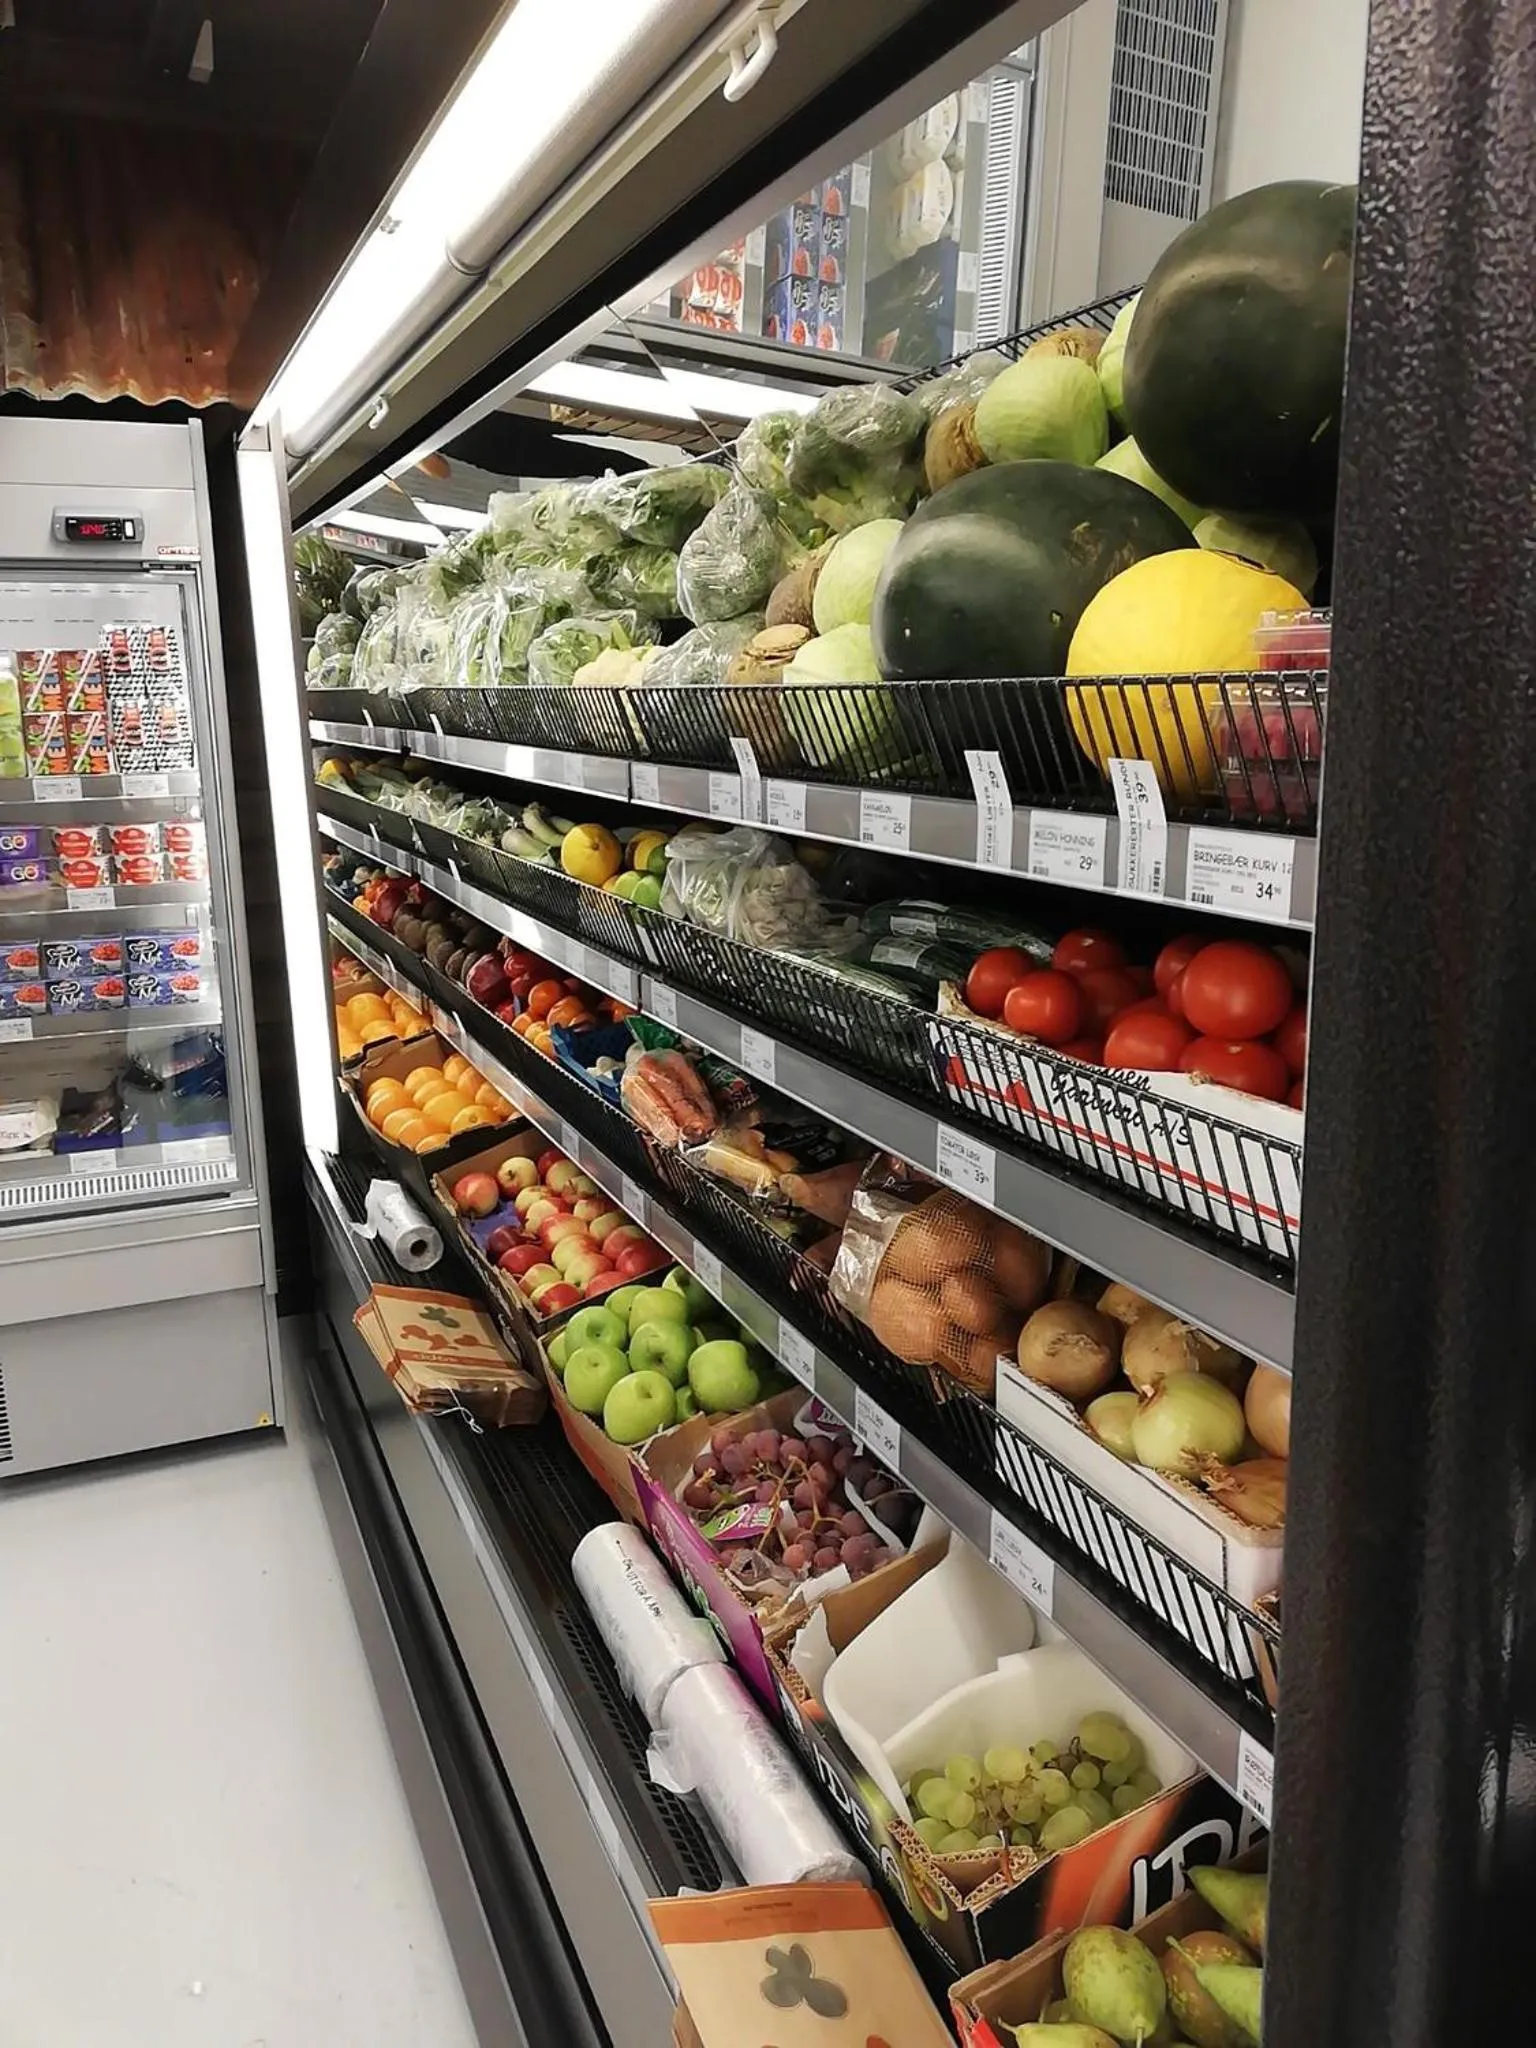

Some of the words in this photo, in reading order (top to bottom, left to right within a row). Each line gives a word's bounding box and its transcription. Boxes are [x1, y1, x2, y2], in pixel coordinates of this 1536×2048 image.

[1135, 782, 1149, 804] 39
[1127, 804, 1138, 889] SUKKERERTER
[1079, 855, 1092, 871] 29
[1194, 850, 1248, 868] BRINGEBÆR
[1252, 858, 1279, 873] KURV
[1256, 882, 1273, 900] 34
